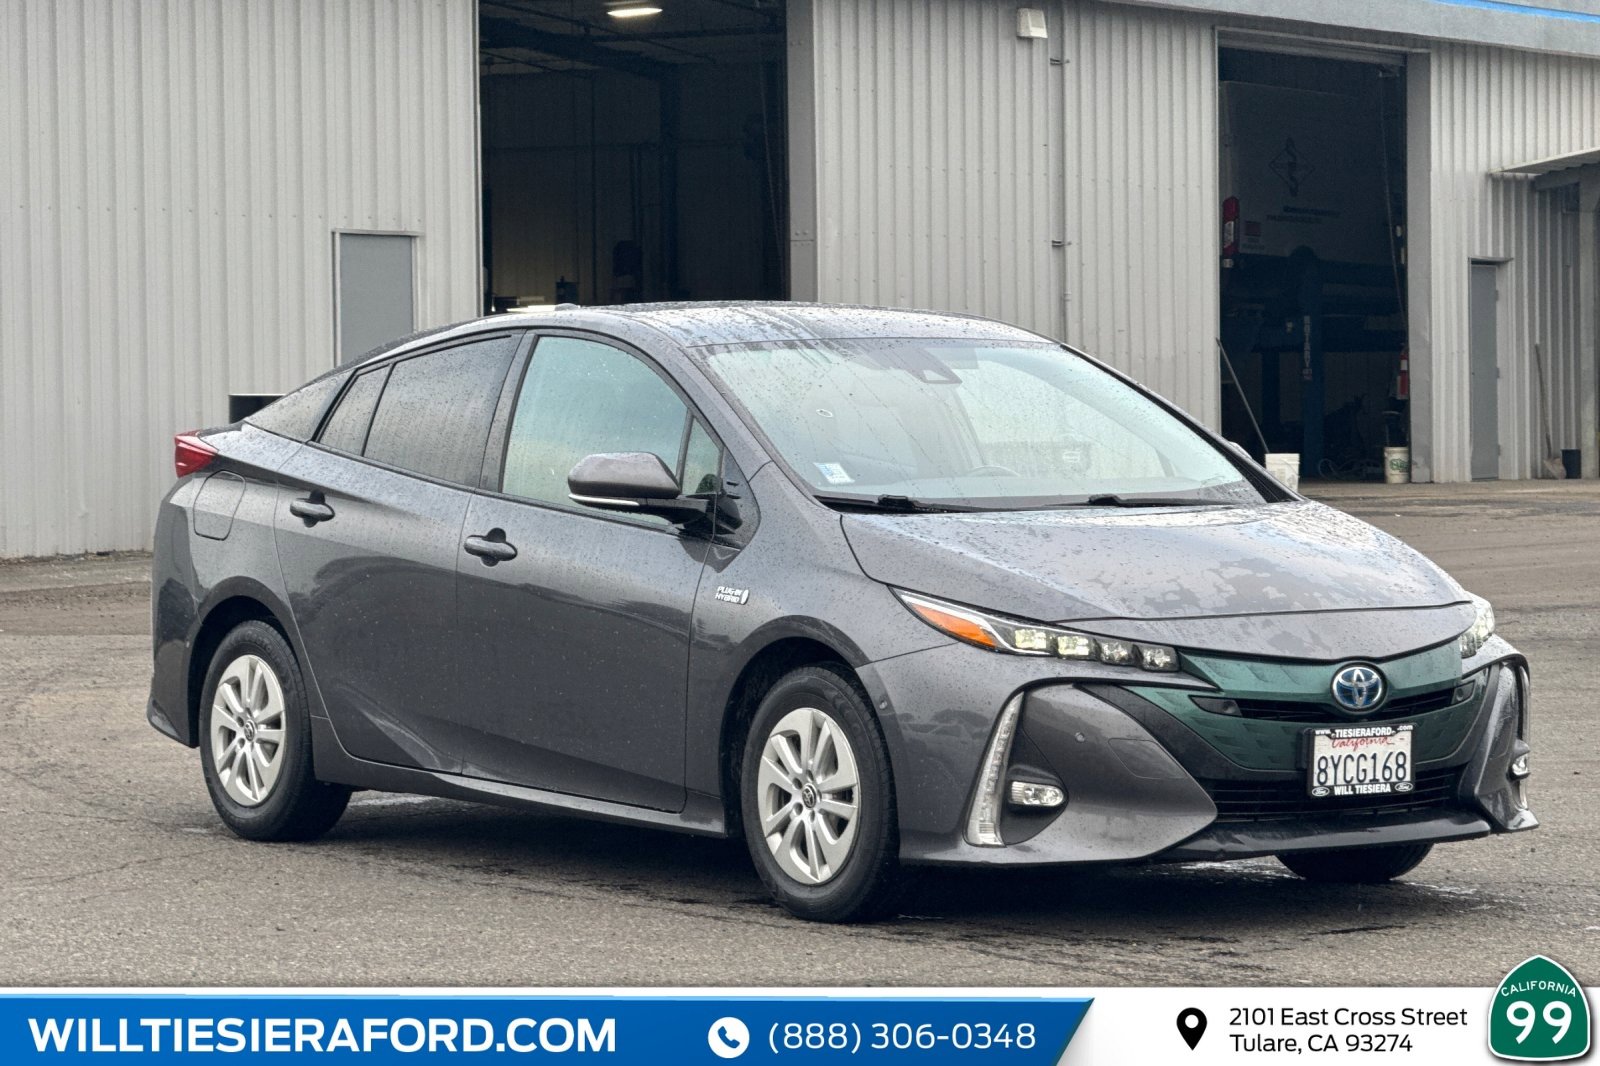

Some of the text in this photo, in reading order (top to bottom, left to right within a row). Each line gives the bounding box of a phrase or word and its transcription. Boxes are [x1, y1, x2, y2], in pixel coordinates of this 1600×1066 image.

[1335, 726, 1392, 738] TIESIERAFORD
[1317, 751, 1406, 785] 8YCG168
[1334, 783, 1391, 796] WILL TIESIERA
